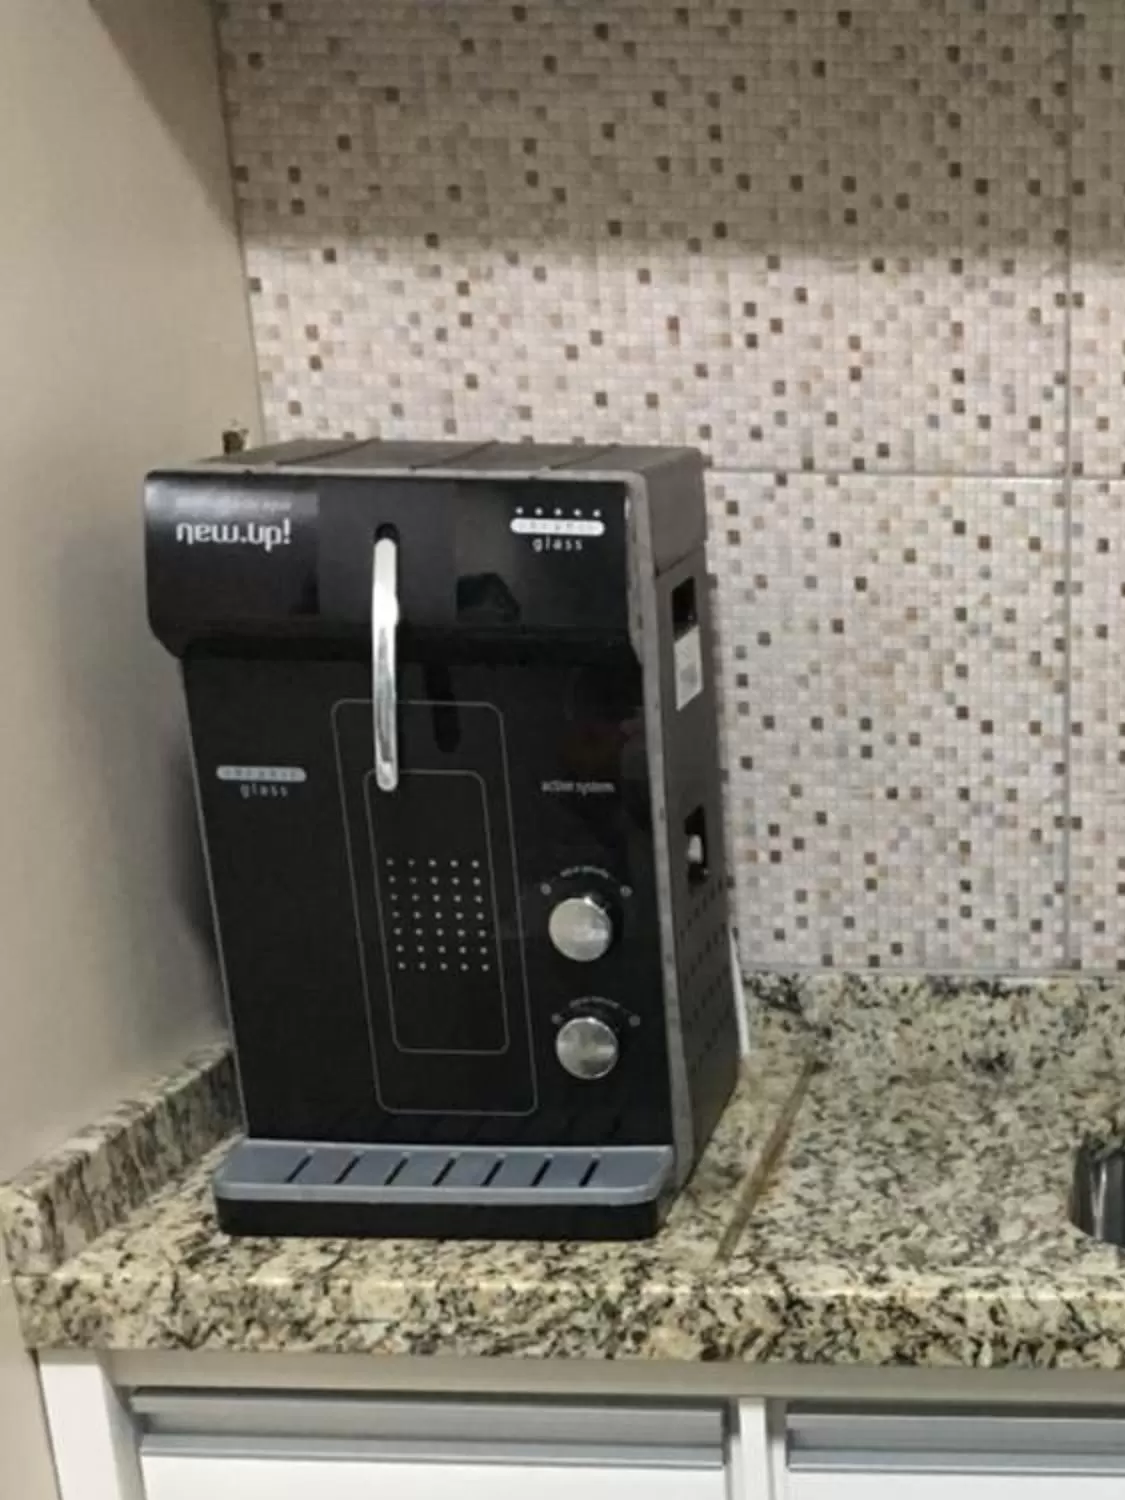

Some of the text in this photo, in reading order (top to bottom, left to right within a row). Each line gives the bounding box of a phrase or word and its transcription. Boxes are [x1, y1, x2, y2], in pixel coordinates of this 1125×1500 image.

[176, 517, 292, 552] new.up!
[532, 535, 583, 552] glass
[240, 783, 289, 799] glass
